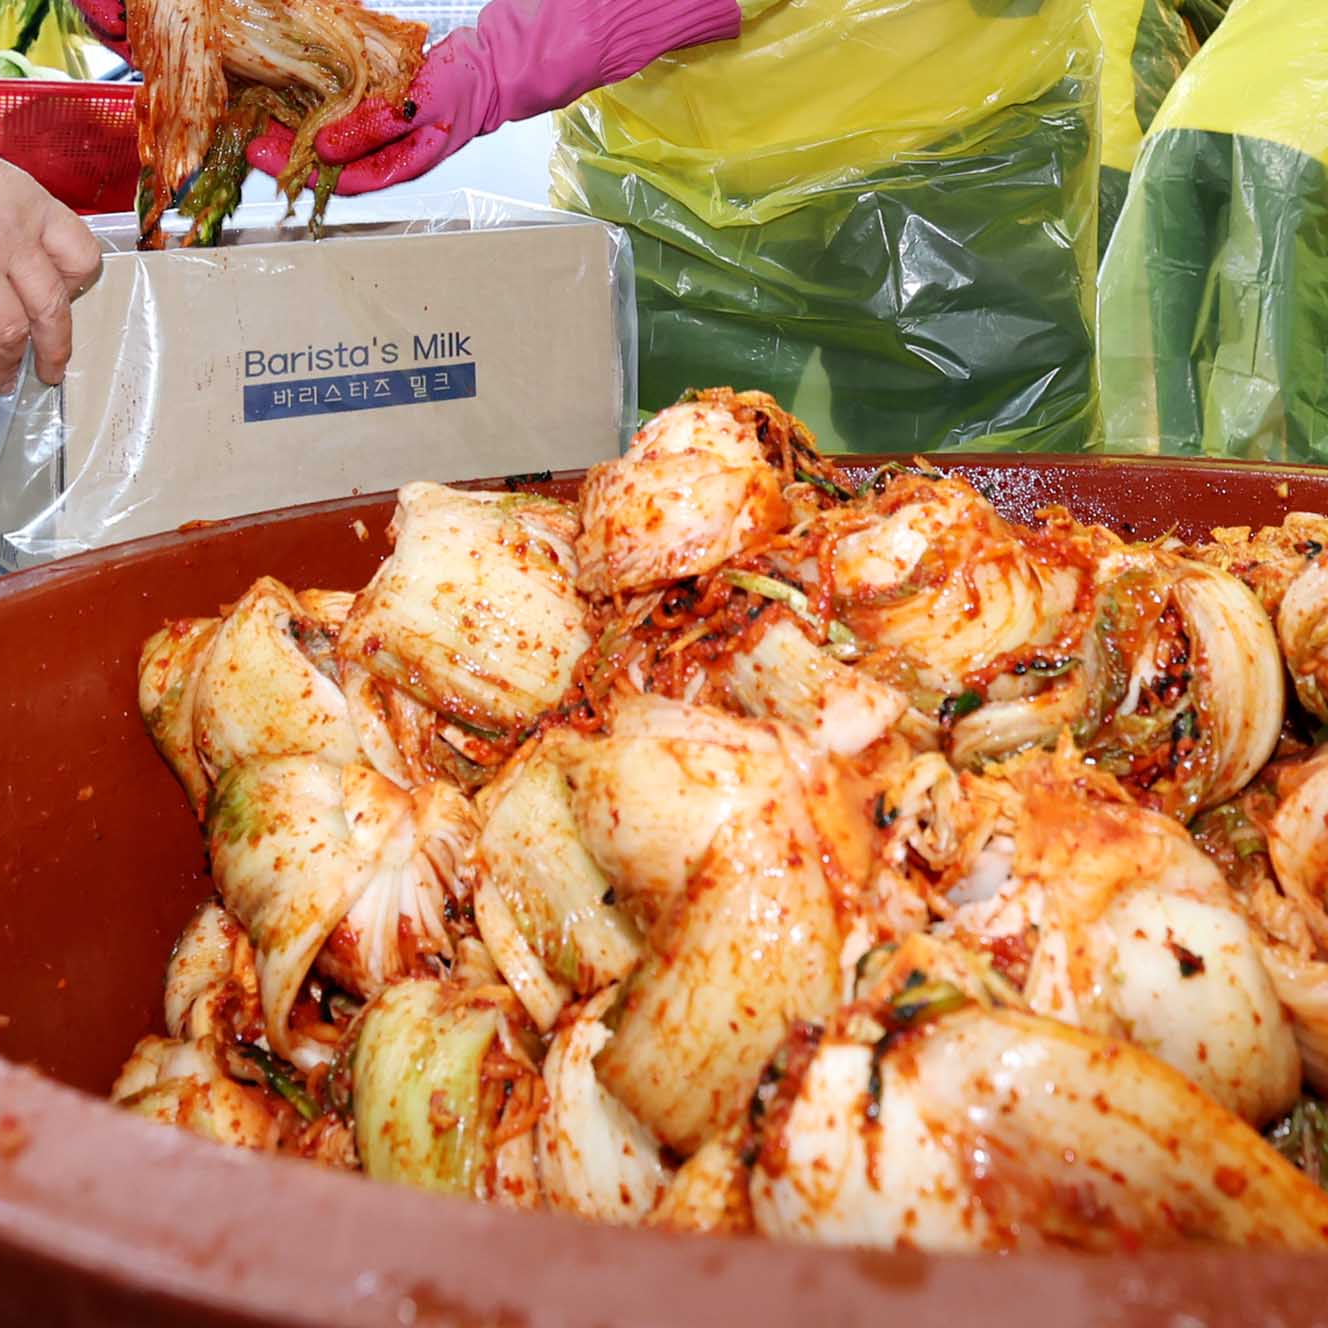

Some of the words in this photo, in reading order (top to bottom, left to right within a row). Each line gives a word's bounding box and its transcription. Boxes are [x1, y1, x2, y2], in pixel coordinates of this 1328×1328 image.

[244, 336, 399, 378] Barista's
[413, 331, 472, 361] Milk
[273, 377, 392, 408] 바리스타즈
[409, 372, 452, 399] 밀크
